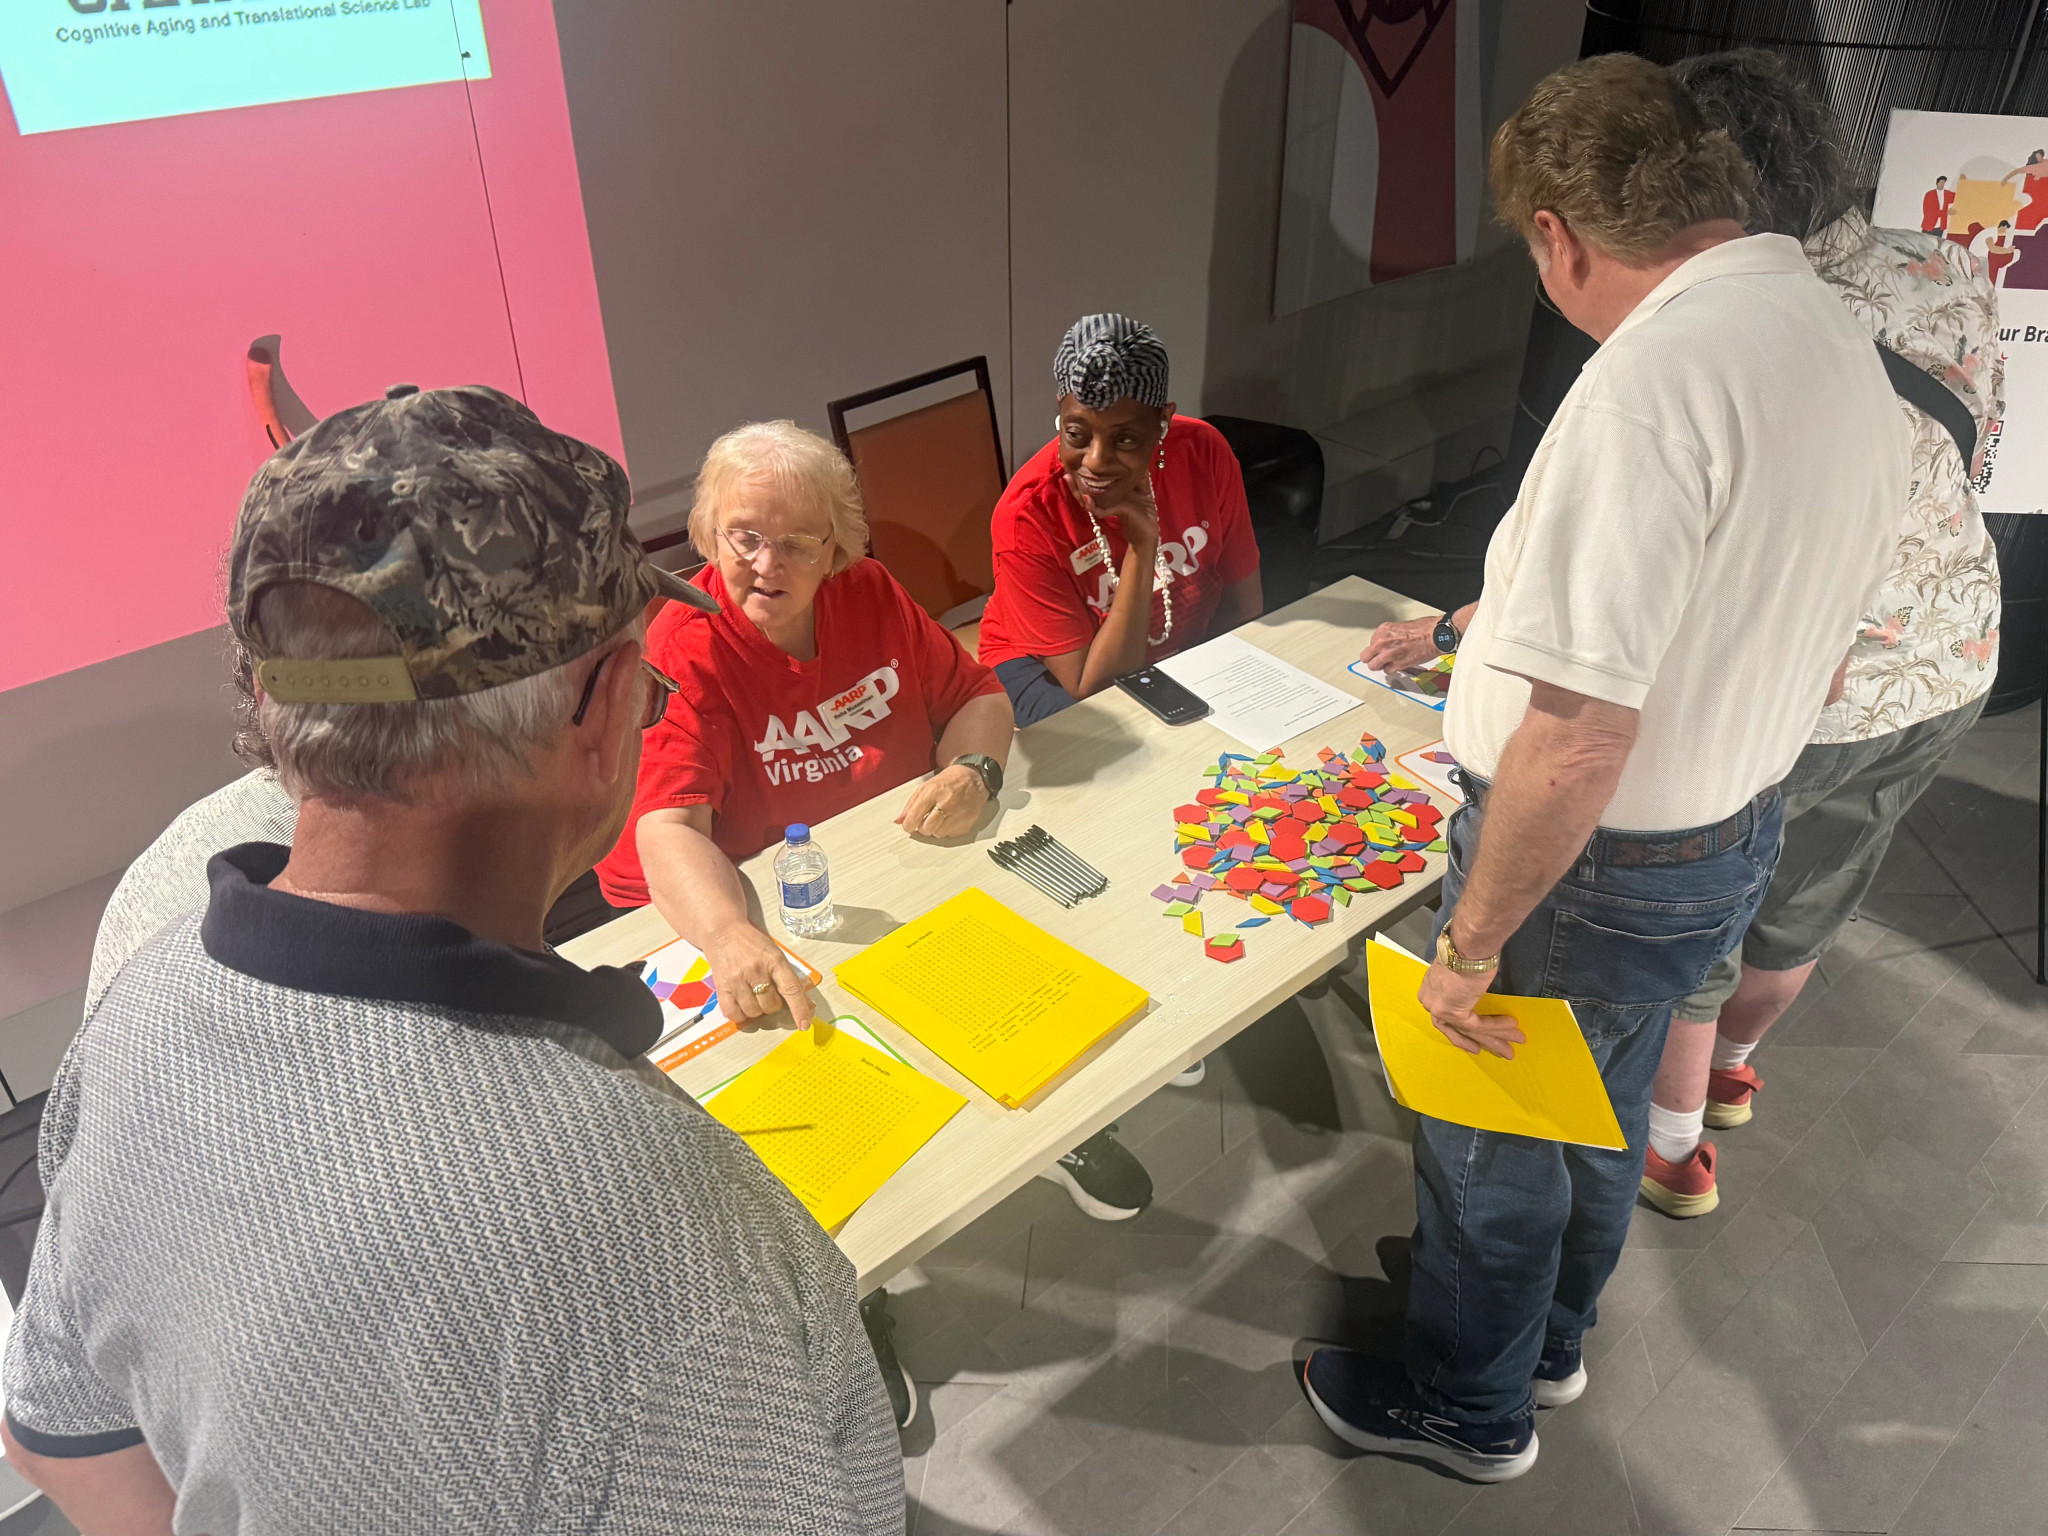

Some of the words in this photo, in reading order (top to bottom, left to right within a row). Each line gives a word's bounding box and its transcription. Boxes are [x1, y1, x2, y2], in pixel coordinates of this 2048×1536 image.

[56, 22, 141, 43] Cognitive
[146, 17, 195, 36] Aging
[200, 12, 231, 28] and
[233, 3, 336, 26] Translational
[340, 0, 399, 15] Science
[831, 684, 867, 711] AARP
[764, 745, 864, 786] Virginia
[860, 1057, 874, 1067] Brain
